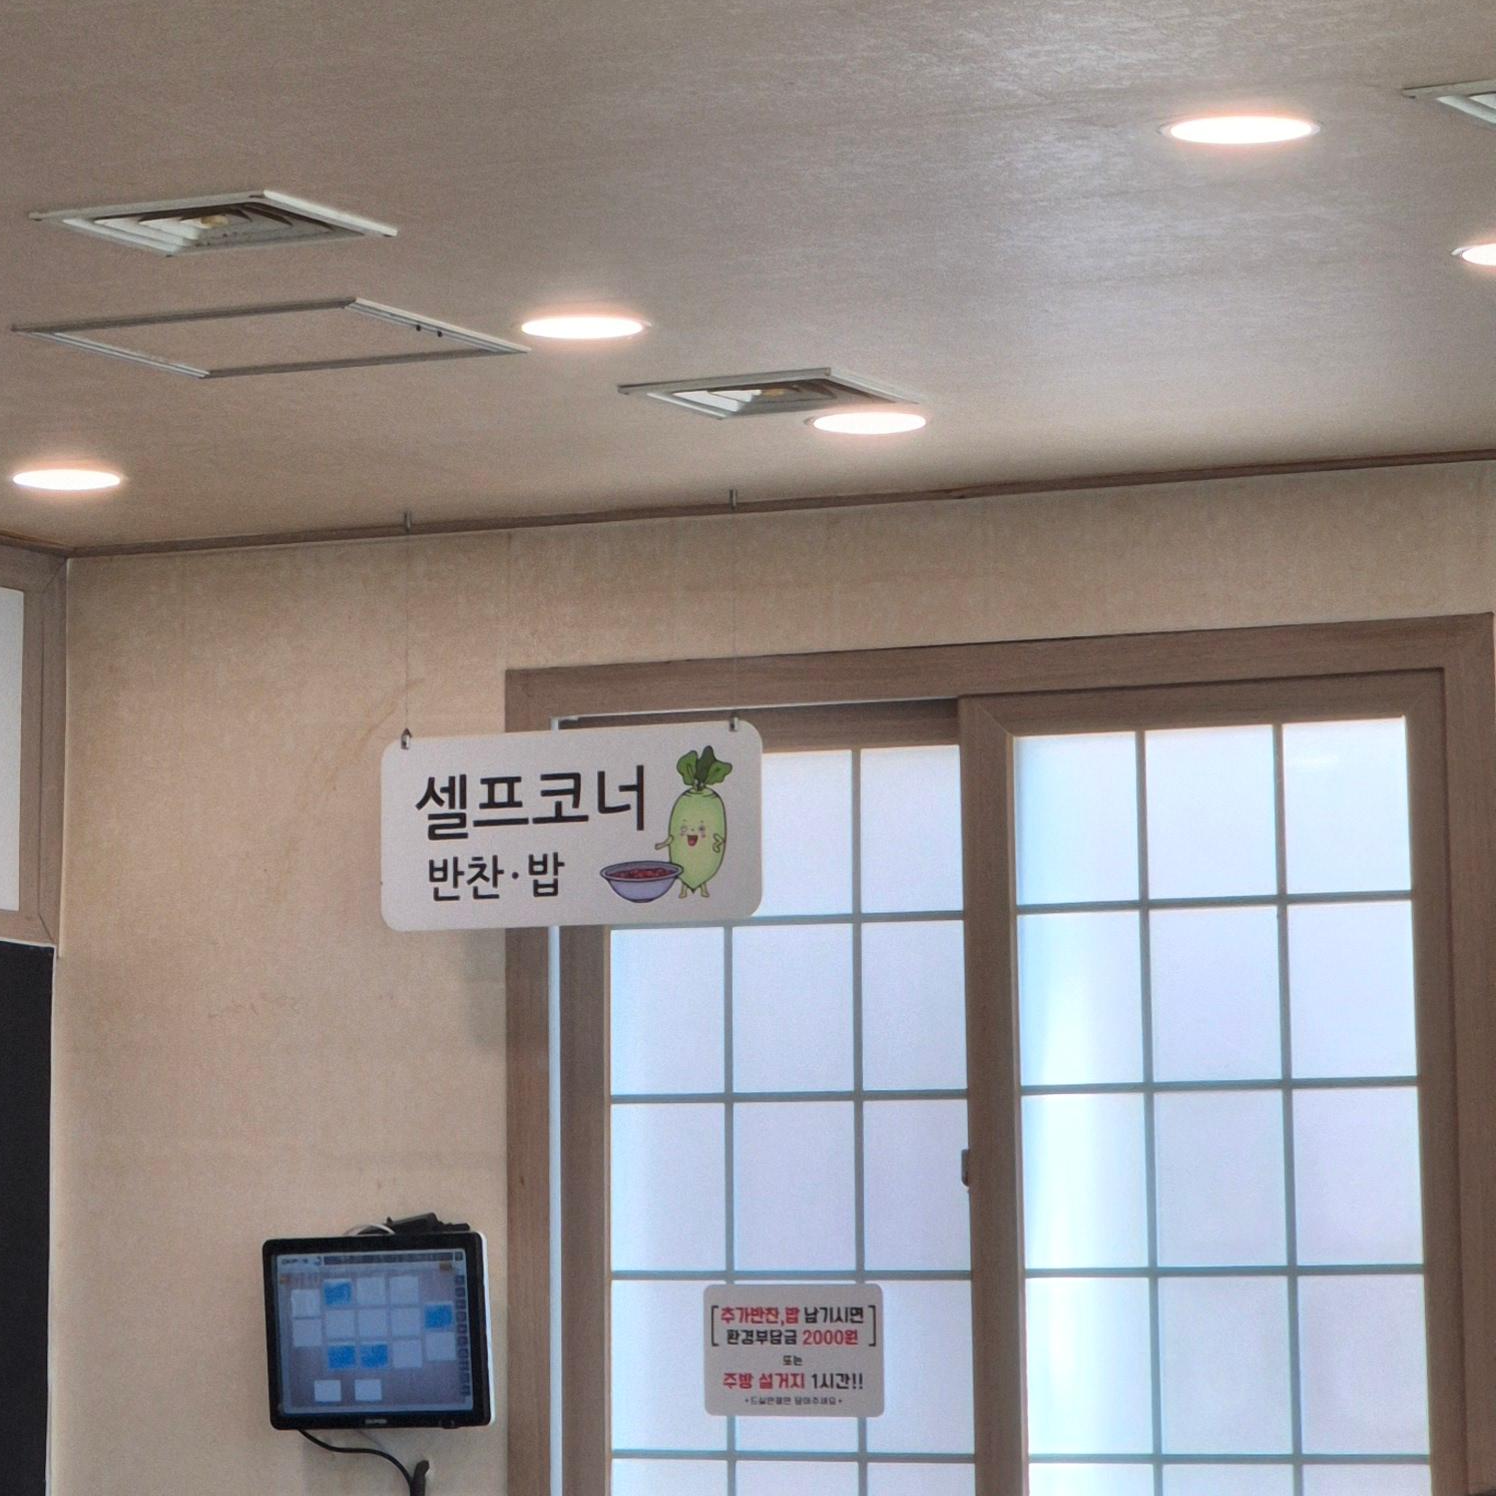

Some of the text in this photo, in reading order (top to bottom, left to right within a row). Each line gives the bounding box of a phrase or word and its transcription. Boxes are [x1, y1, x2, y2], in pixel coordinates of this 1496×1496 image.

[415, 765, 645, 841] 셀프코너
[804, 1306, 865, 1324] 남기시면
[726, 1329, 859, 1346] 환경부담금 2000원
[782, 1355, 803, 1367] 또는
[723, 1372, 864, 1390] 주방 설거지 1시간!!
